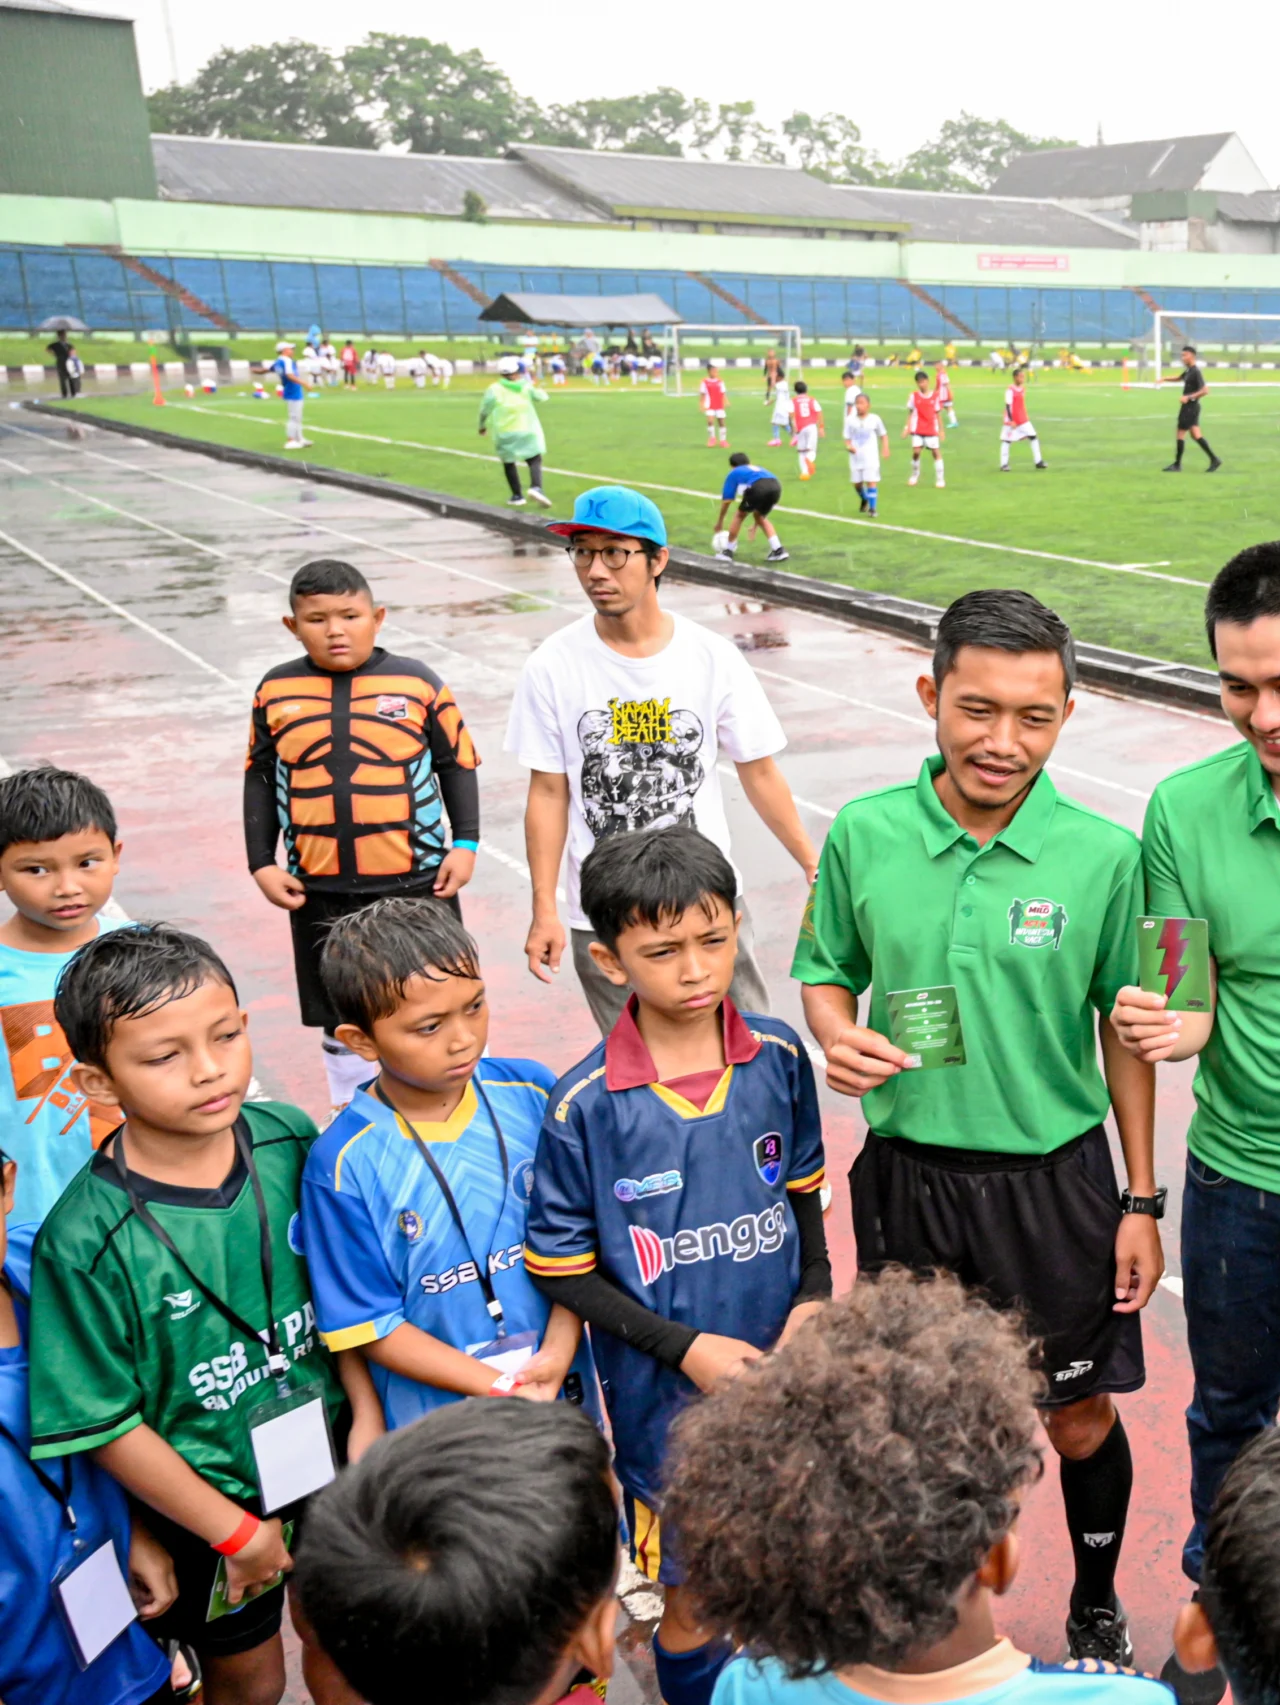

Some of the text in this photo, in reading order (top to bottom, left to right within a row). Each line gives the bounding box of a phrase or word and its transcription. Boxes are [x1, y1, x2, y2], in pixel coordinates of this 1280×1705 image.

[607, 697, 673, 725] NAPALM
[606, 720, 678, 746] DEATH
[1028, 906, 1050, 915] MILO
[420, 1260, 479, 1295] SSB
[188, 1341, 248, 1397] SSB
